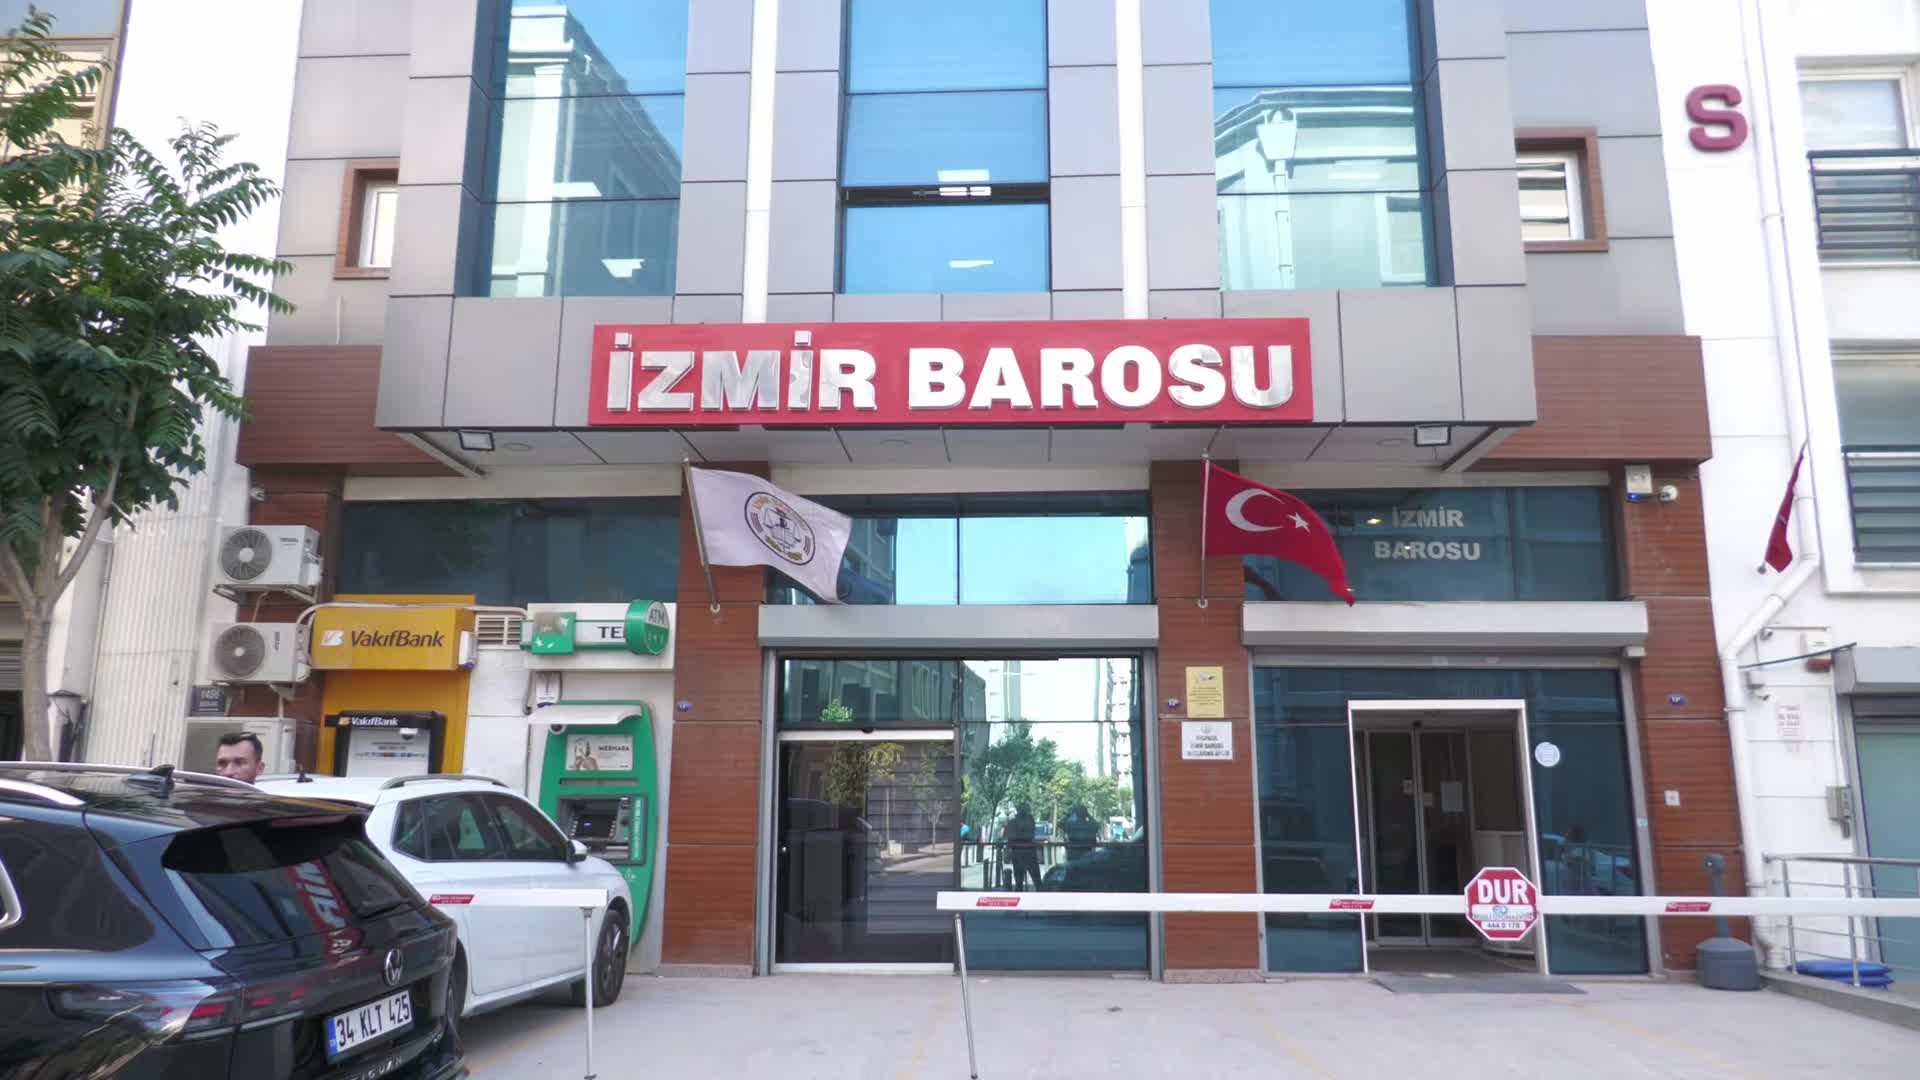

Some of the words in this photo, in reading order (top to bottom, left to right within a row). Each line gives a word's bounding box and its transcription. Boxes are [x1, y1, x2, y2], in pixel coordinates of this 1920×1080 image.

[1685, 84, 1748, 153] S
[607, 331, 876, 412] İZMİR
[908, 343, 1294, 411] BAROSU
[1392, 506, 1464, 528] İZMİR
[1374, 541, 1480, 560] BAROSU
[648, 607, 665, 625] ATM
[351, 630, 445, 648] VakıfBank
[598, 626, 625, 639] TE
[1477, 879, 1529, 904] DUR
[336, 1015, 355, 1047] 34
[360, 1004, 383, 1038] KLT
[389, 993, 411, 1024] 425
